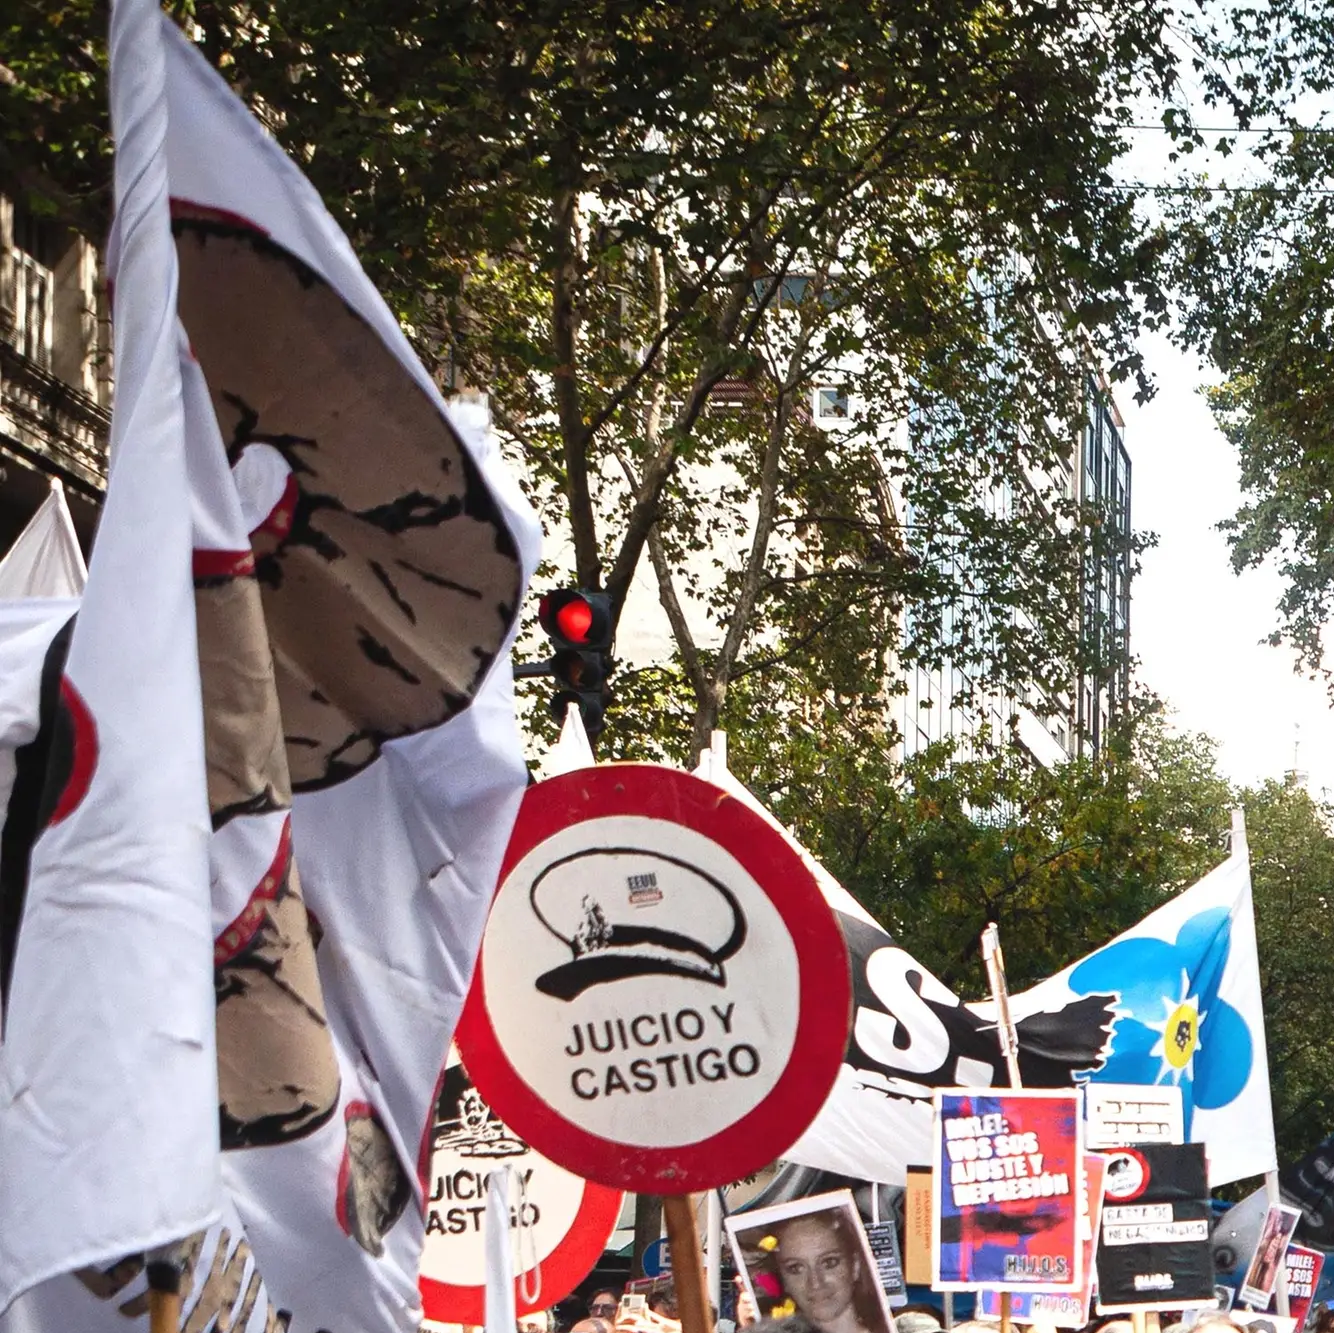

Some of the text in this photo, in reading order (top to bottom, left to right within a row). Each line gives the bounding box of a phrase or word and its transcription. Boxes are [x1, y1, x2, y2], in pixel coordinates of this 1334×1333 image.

[565, 1002, 735, 1057] JUICIO Y
[571, 1043, 760, 1100] CASTIGO
[1027, 1153, 1044, 1176] Y
[1294, 1269, 1313, 1283] SOS
[1288, 1282, 1312, 1298] ASTA
